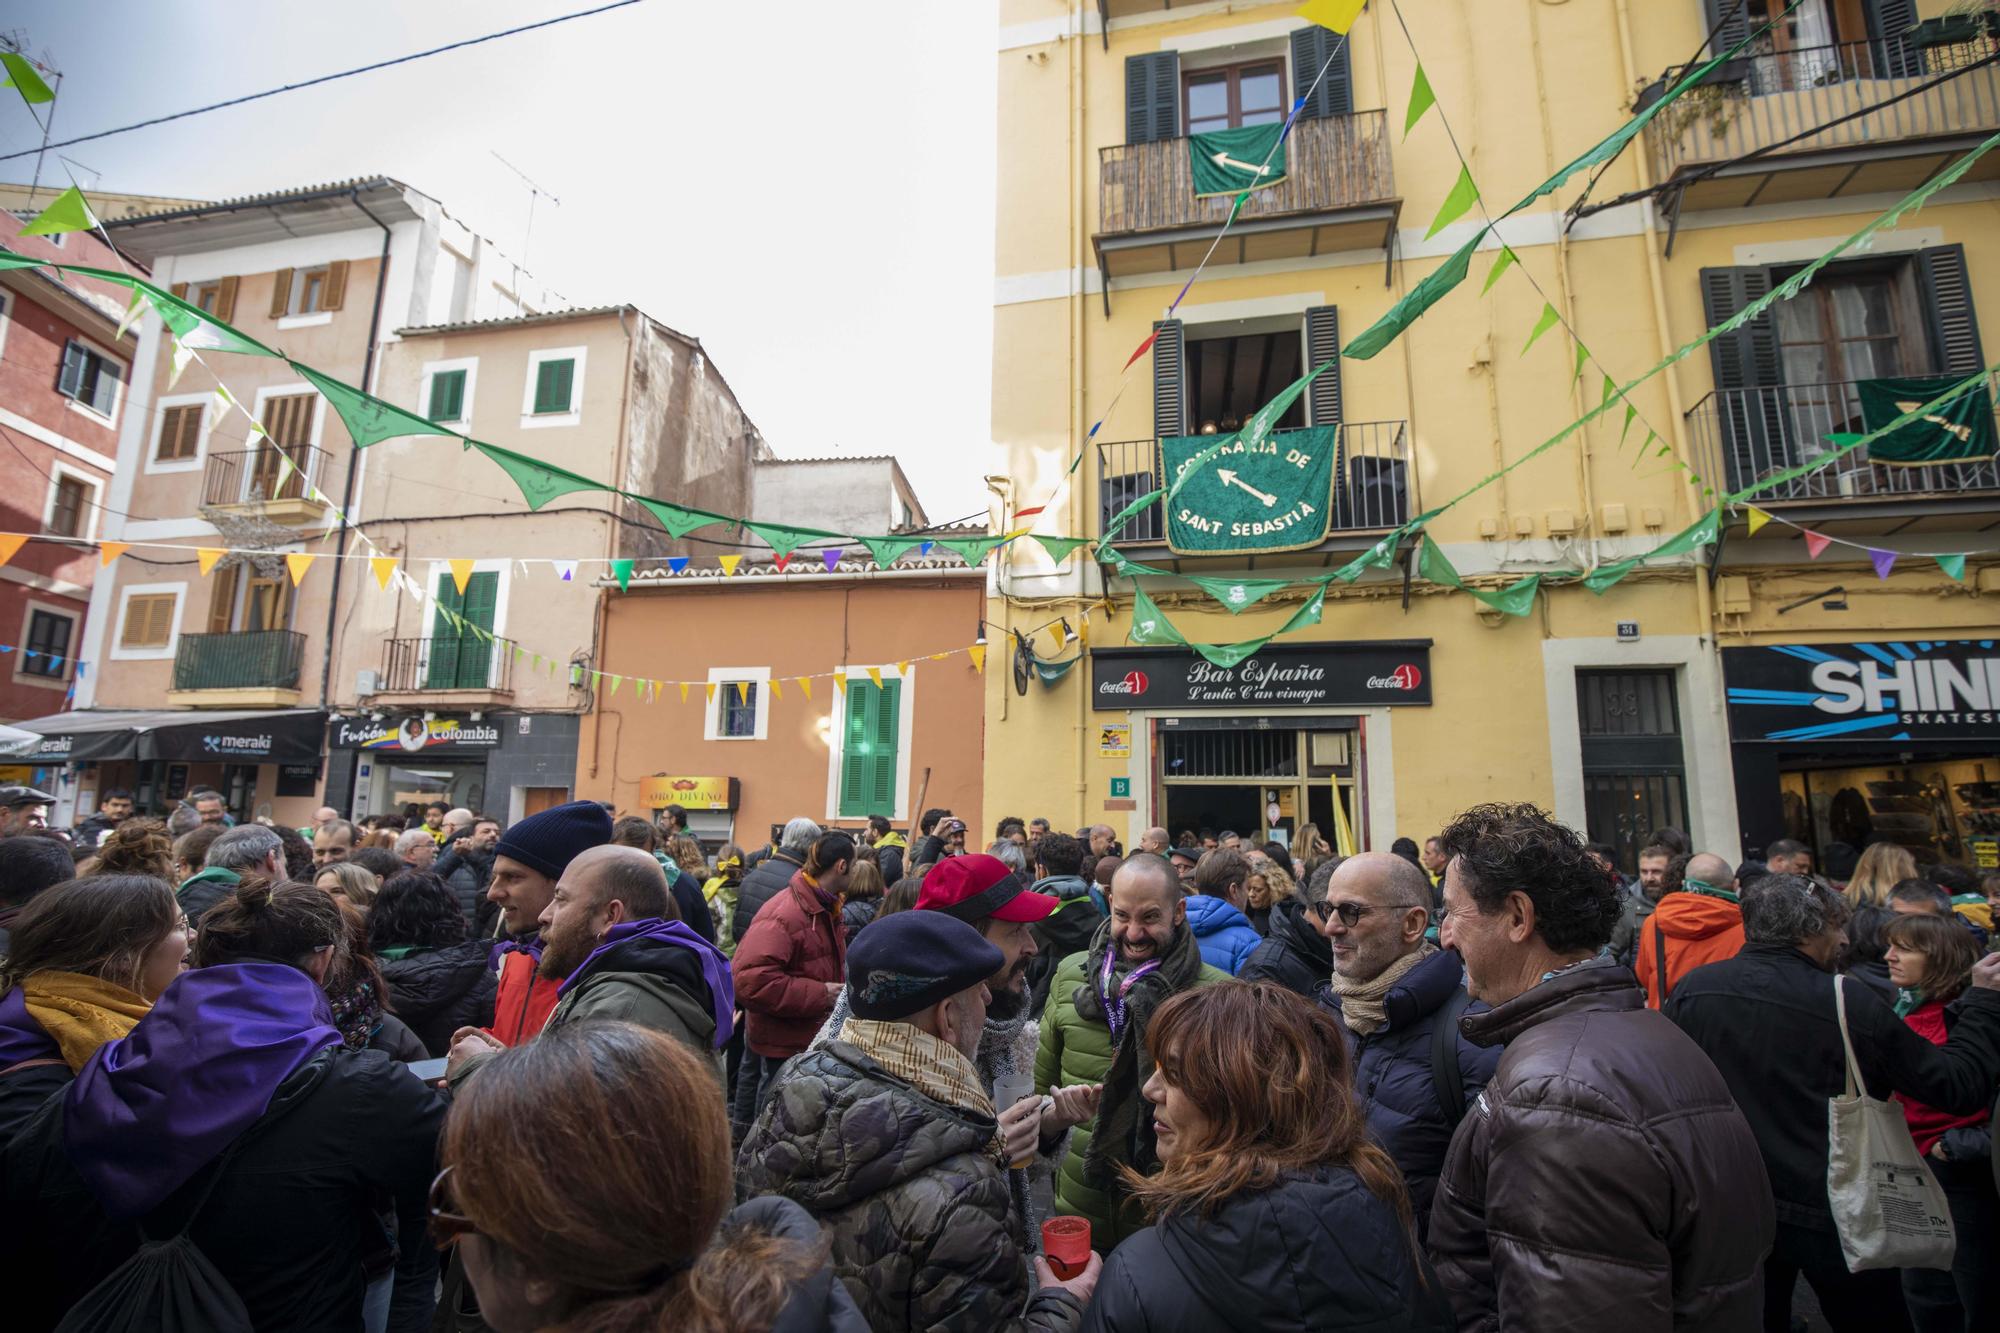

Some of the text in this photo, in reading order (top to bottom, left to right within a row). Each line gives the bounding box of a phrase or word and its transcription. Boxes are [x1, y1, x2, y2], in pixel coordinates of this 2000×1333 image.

[1285, 448, 1312, 469] DE
[1178, 501, 1316, 536] SANT SEBASTIÀ
[1187, 659, 1325, 689] Bar España
[1276, 687, 1326, 704] vinagre
[1903, 711, 2000, 724] SKATES
[222, 734, 272, 749] meraki
[339, 724, 498, 745] Fusión Colombia
[41, 736, 73, 752] eraki
[1116, 781, 1126, 793] B
[650, 791, 722, 800] ORO DIVINO
